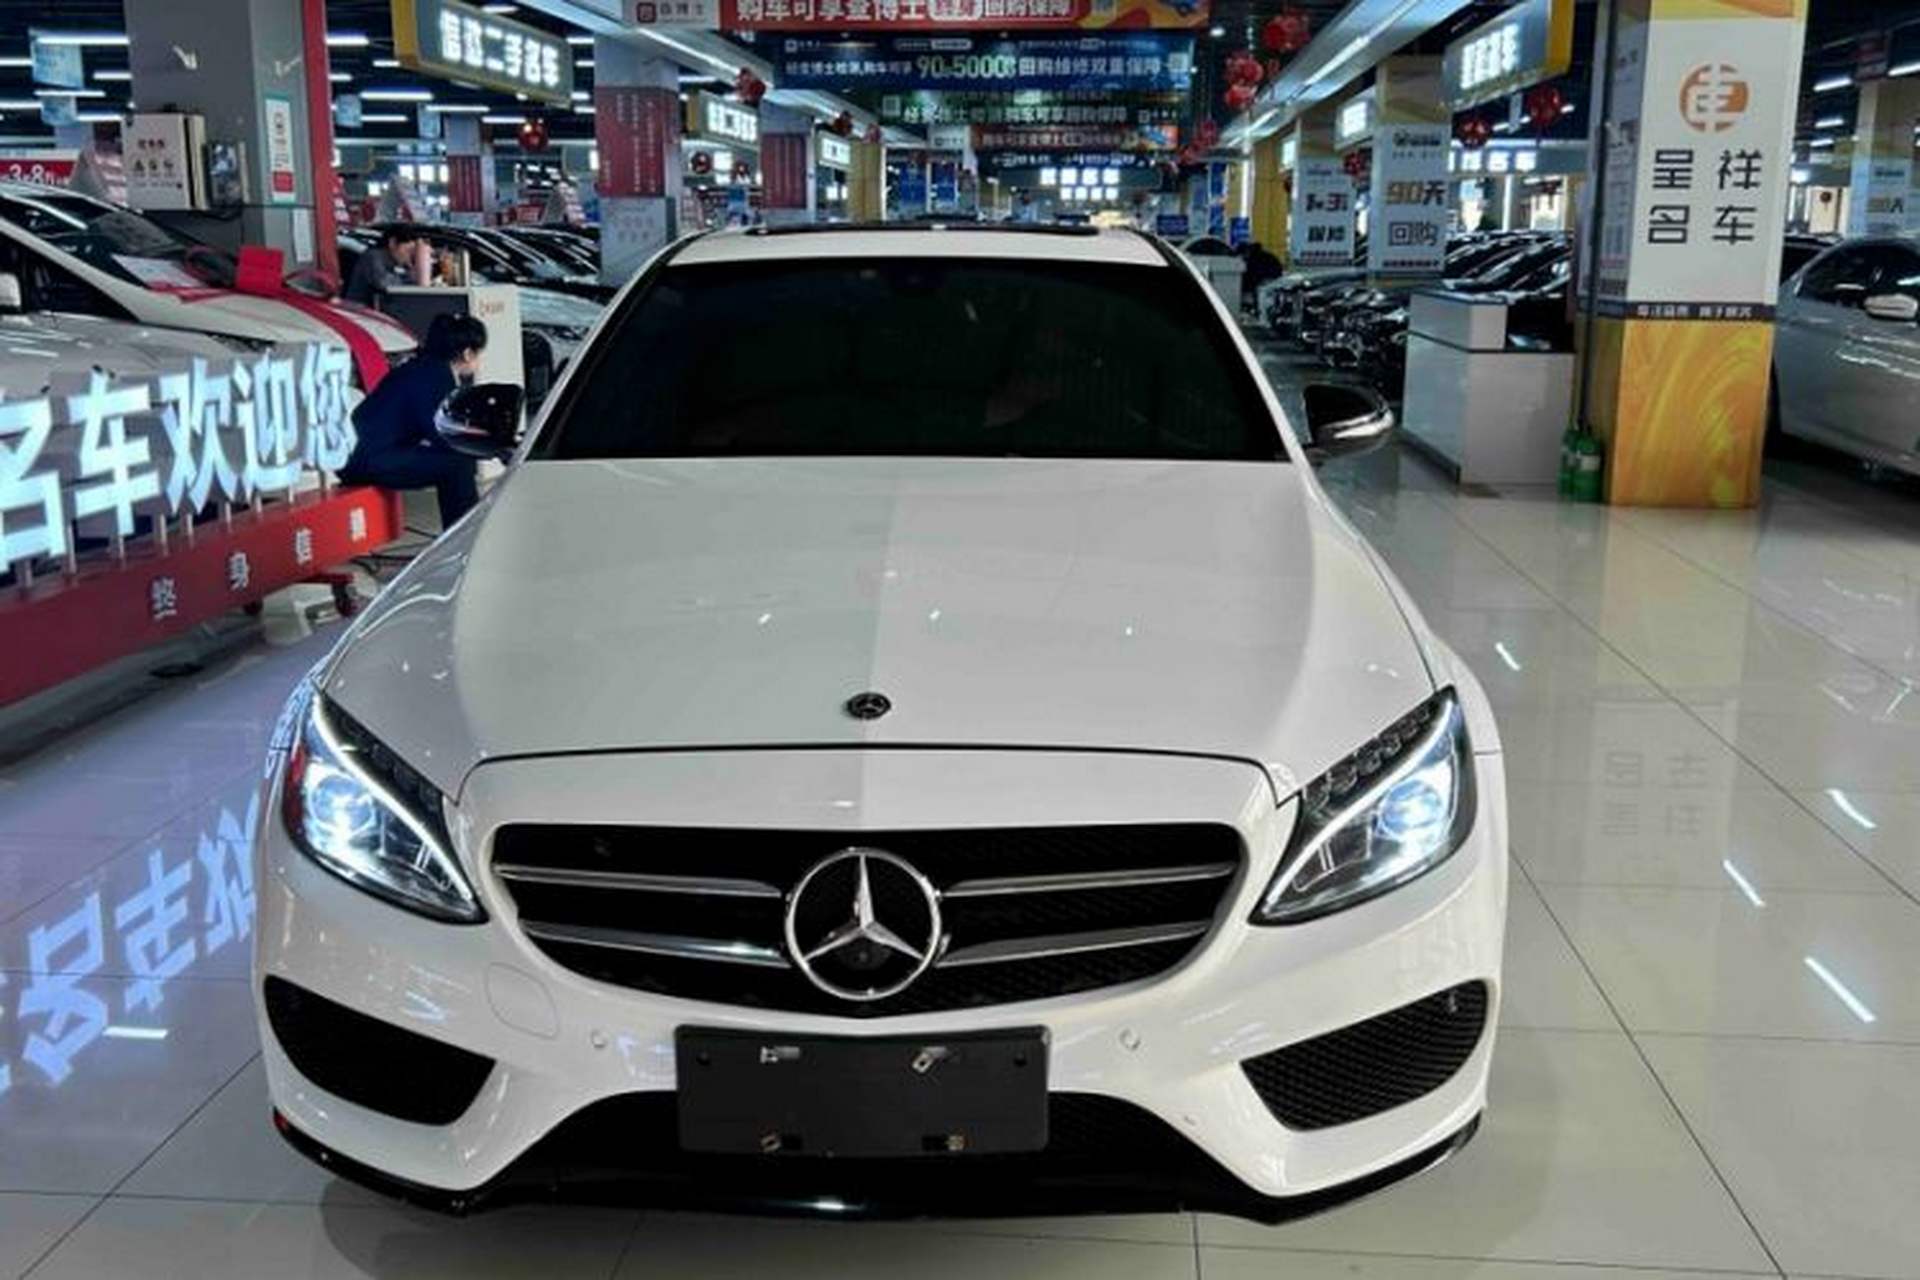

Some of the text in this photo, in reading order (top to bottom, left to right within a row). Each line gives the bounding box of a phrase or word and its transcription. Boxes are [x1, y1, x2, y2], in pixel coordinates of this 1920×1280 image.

[1652, 149, 1763, 190] 呈祥
[1647, 204, 1757, 246] 名车
[0, 339, 358, 575] 名车欢迎您
